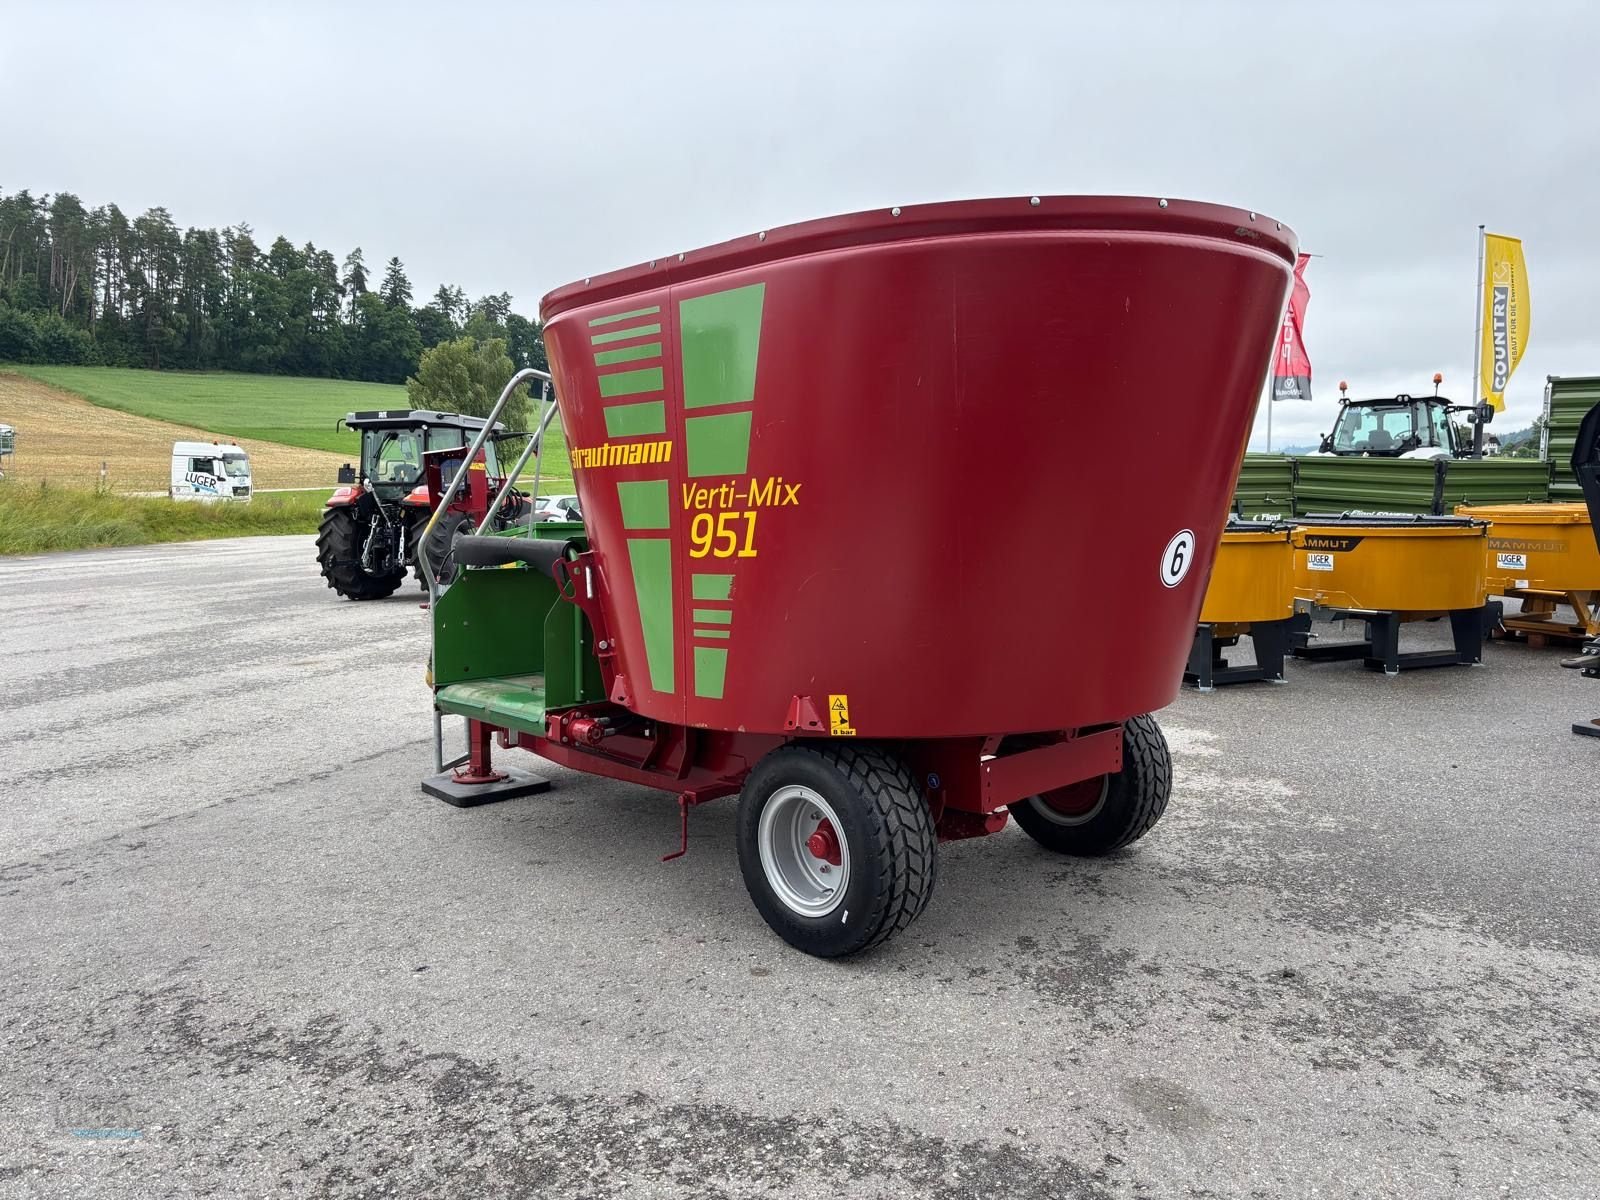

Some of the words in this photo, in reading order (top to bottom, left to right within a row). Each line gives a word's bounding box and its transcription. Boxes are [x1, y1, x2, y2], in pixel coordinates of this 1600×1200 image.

[1494, 289, 1507, 391] COUNTRY
[571, 440, 673, 469] strautmann
[184, 472, 217, 489] LUGER
[681, 476, 802, 510] Verti-Mix
[689, 511, 758, 558] 951
[1488, 540, 1565, 551] MAMMUT
[1171, 541, 1187, 577] 6
[1308, 554, 1330, 564] LUGER
[1497, 554, 1522, 564] LUGER
